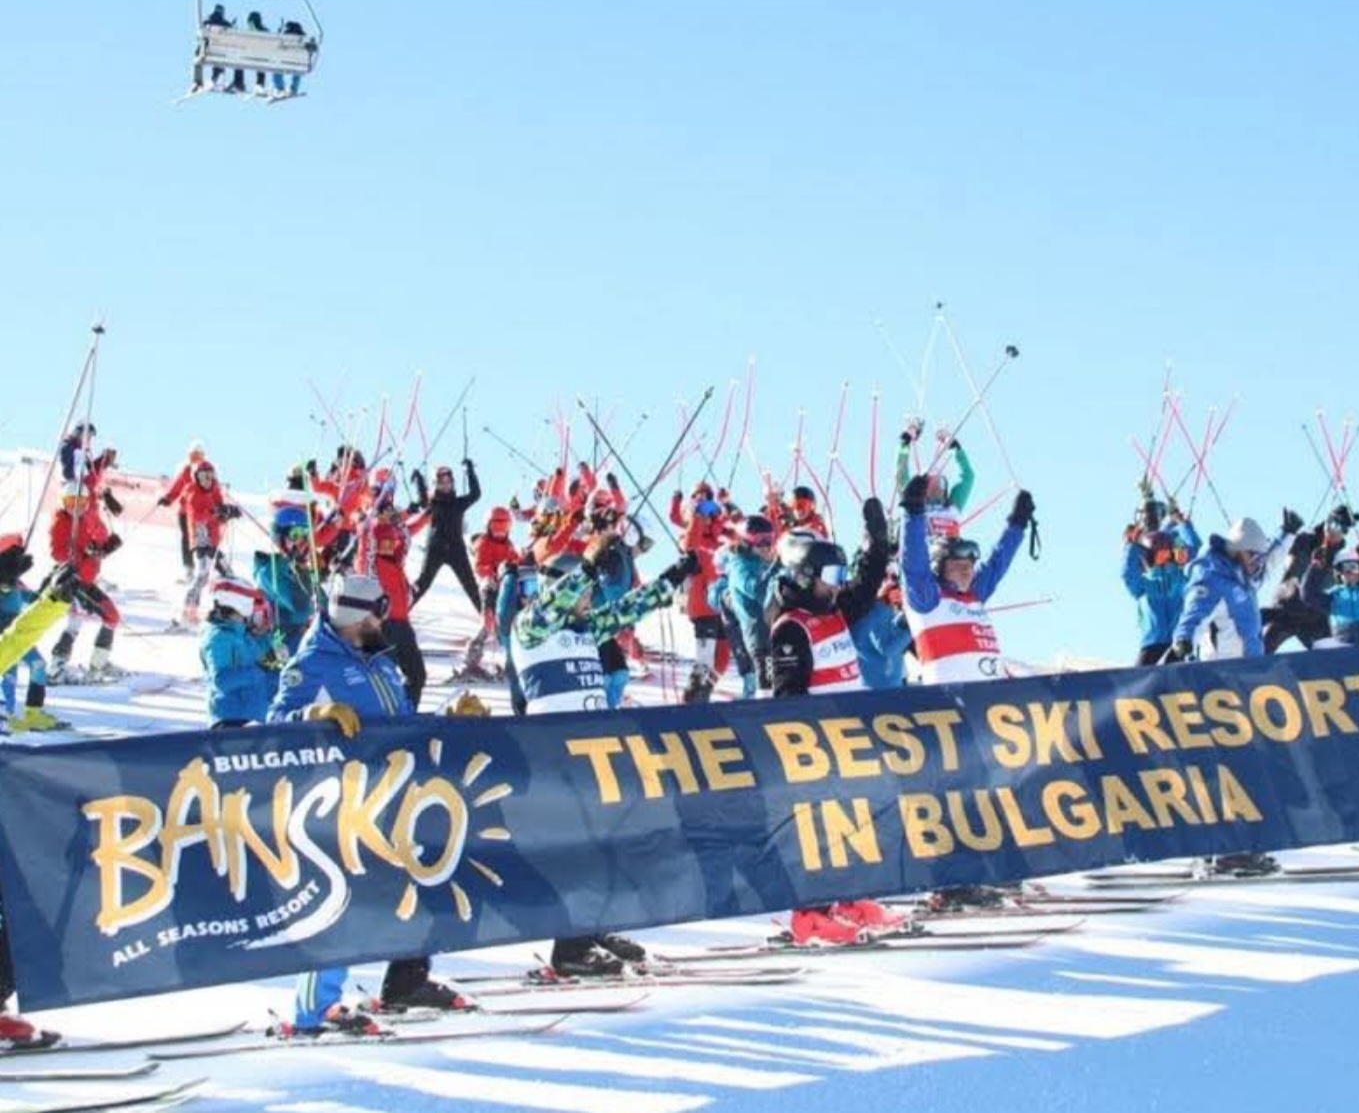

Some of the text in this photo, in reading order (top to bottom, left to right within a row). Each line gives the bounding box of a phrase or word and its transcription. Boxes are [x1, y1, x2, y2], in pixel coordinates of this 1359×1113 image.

[214, 746, 345, 773] BULGARIA
[566, 728, 756, 804] THE
[763, 710, 963, 784] BEST
[986, 700, 1104, 768] SKI
[82, 749, 468, 949] BANSKO
[793, 764, 1264, 871] IN BULGARIA
[112, 879, 321, 967] ALL SEASONS RESORT
